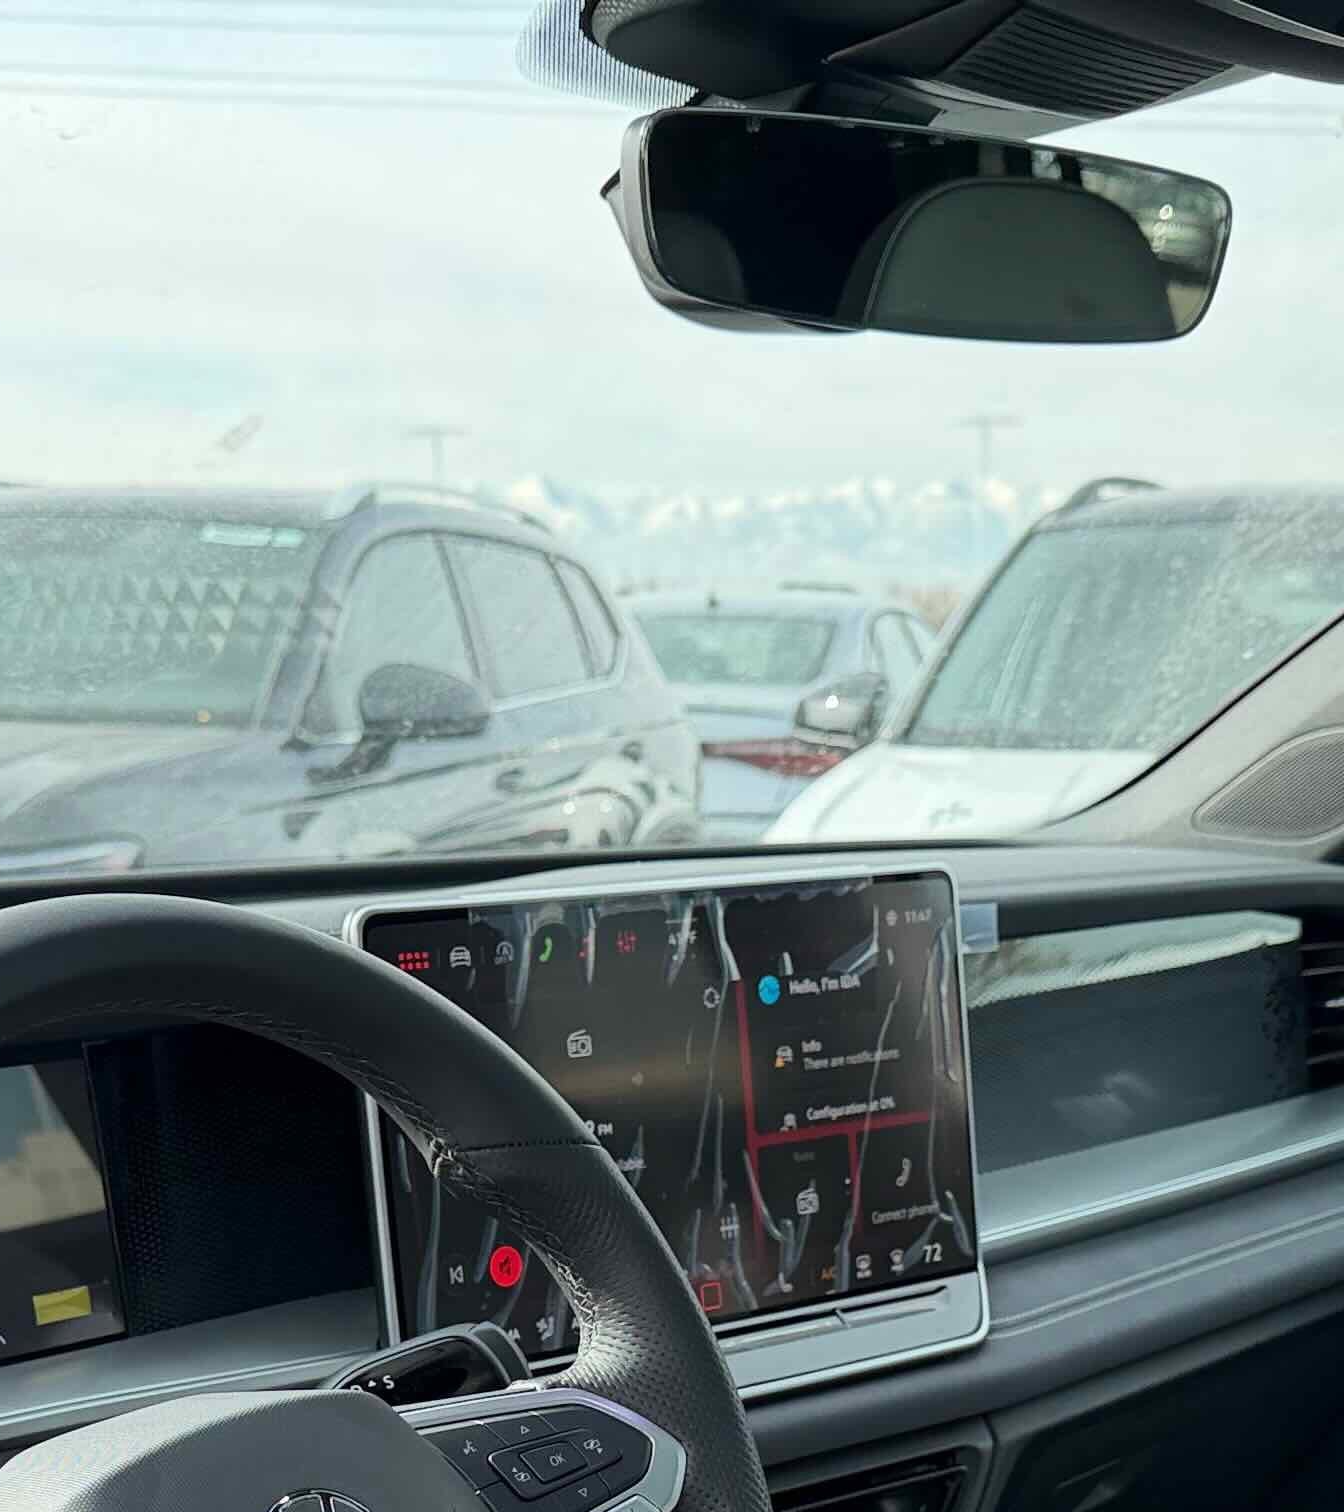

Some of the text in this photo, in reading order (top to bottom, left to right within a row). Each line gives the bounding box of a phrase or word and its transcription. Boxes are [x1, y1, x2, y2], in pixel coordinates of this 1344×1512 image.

[801, 1039, 822, 1053] Info
[803, 1057, 828, 1071] There
[806, 1103, 867, 1121] Configuration
[922, 1243, 944, 1263] 72
[382, 1374, 396, 1390] S
[549, 1453, 567, 1467] OK
